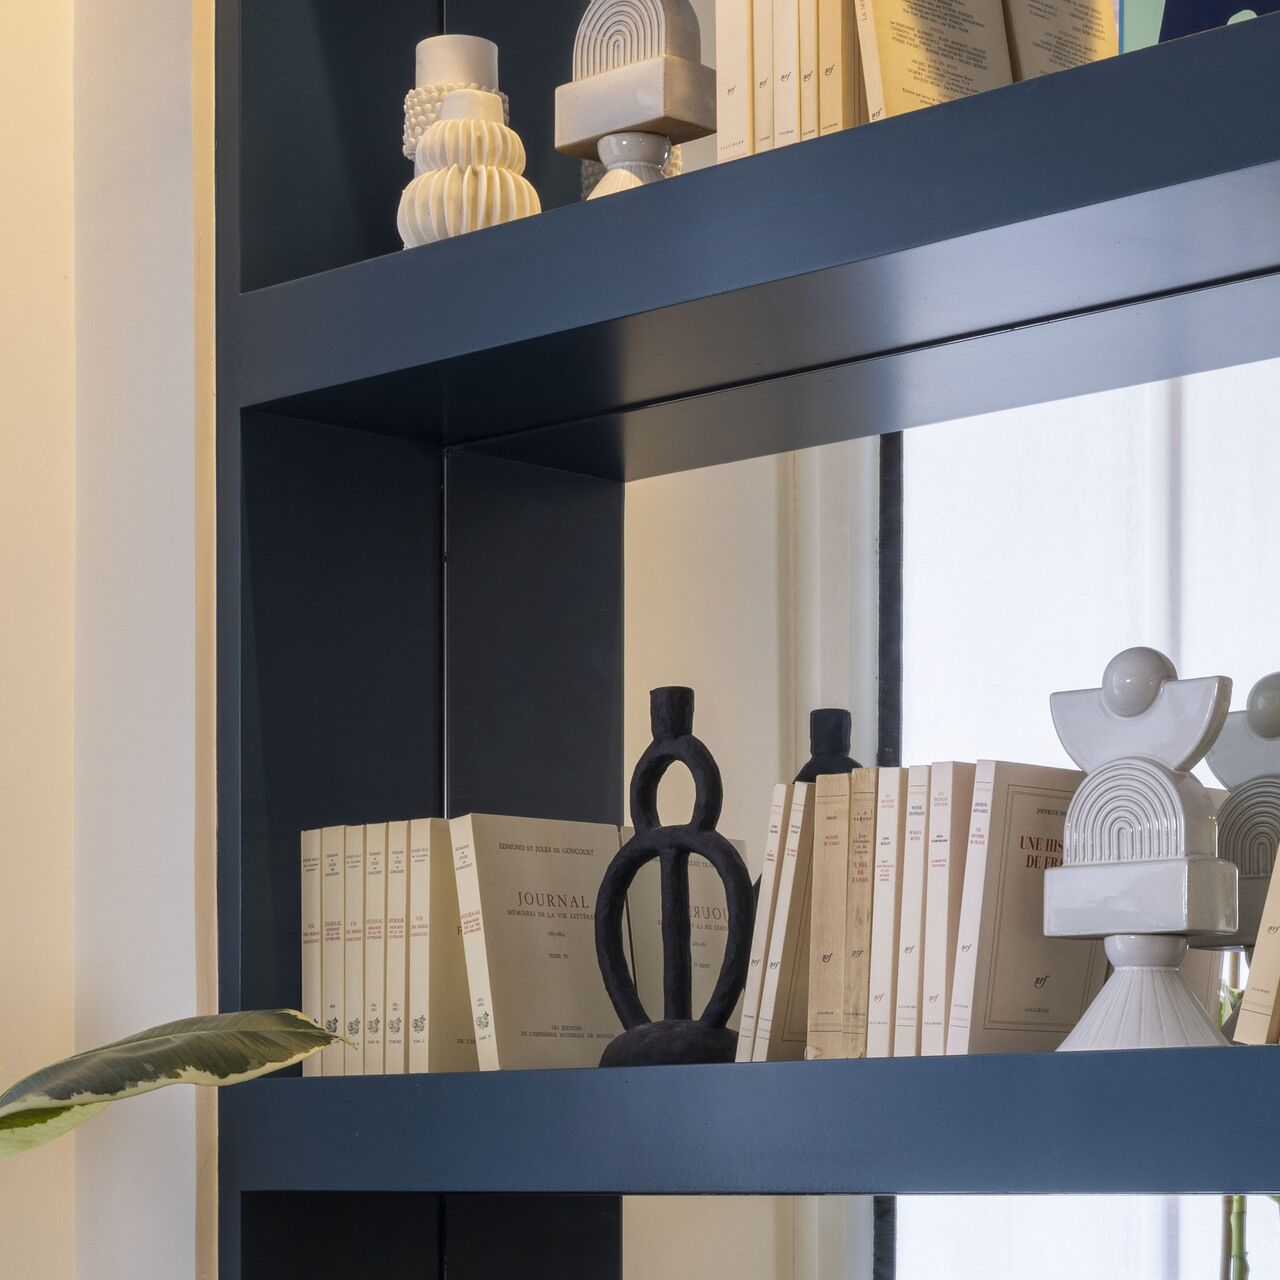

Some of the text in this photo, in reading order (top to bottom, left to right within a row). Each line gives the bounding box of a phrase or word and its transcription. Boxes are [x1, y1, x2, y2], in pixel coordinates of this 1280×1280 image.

[1020, 835, 1064, 853] UNE HIS
[1025, 854, 1041, 869] DE
[518, 891, 590, 909] JOURNAL
